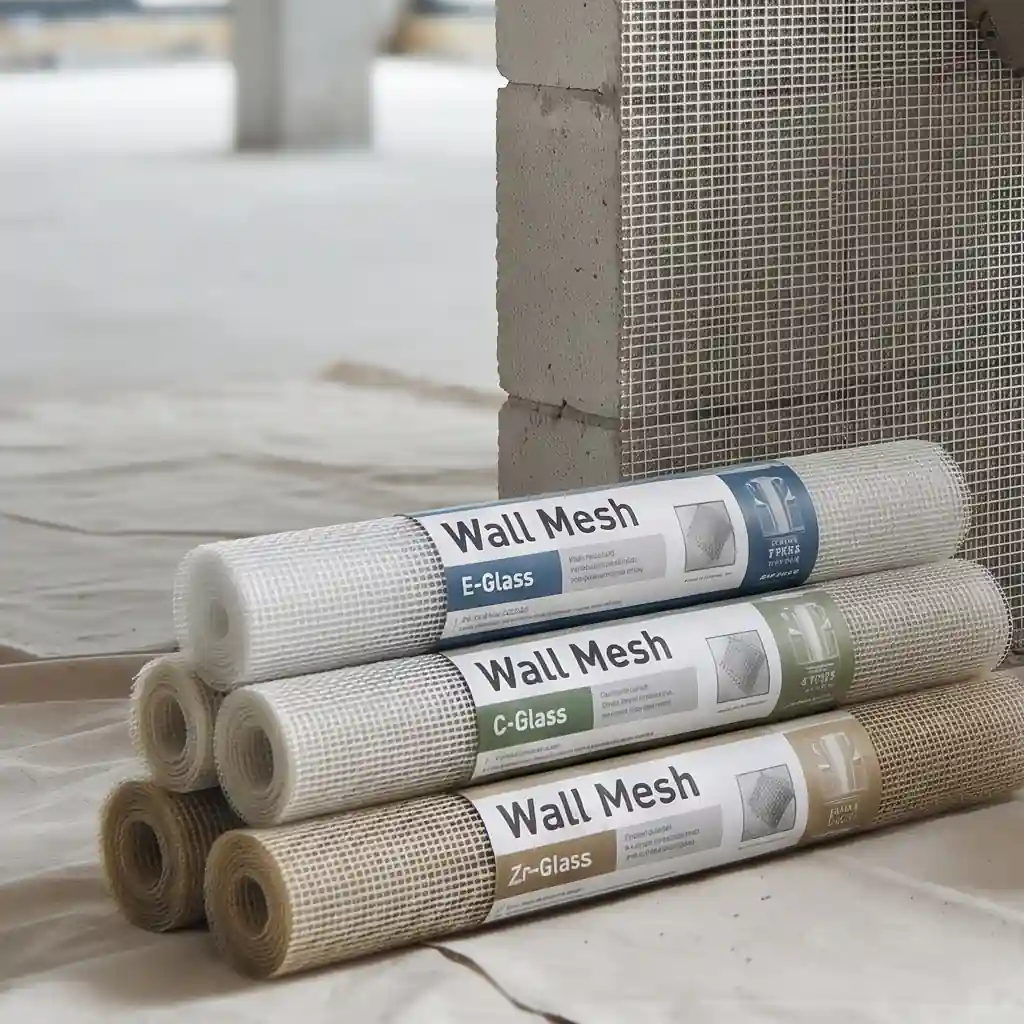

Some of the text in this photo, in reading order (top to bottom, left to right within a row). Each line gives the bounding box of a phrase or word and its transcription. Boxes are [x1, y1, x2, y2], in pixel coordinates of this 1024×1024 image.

[440, 498, 640, 553] Wall Mesh
[461, 570, 534, 596] E-Glass
[473, 630, 673, 692] Wall Mesh
[493, 707, 568, 736] C-Glass
[495, 766, 700, 839] Wall Mesh
[508, 851, 593, 887] Zr-Glass
